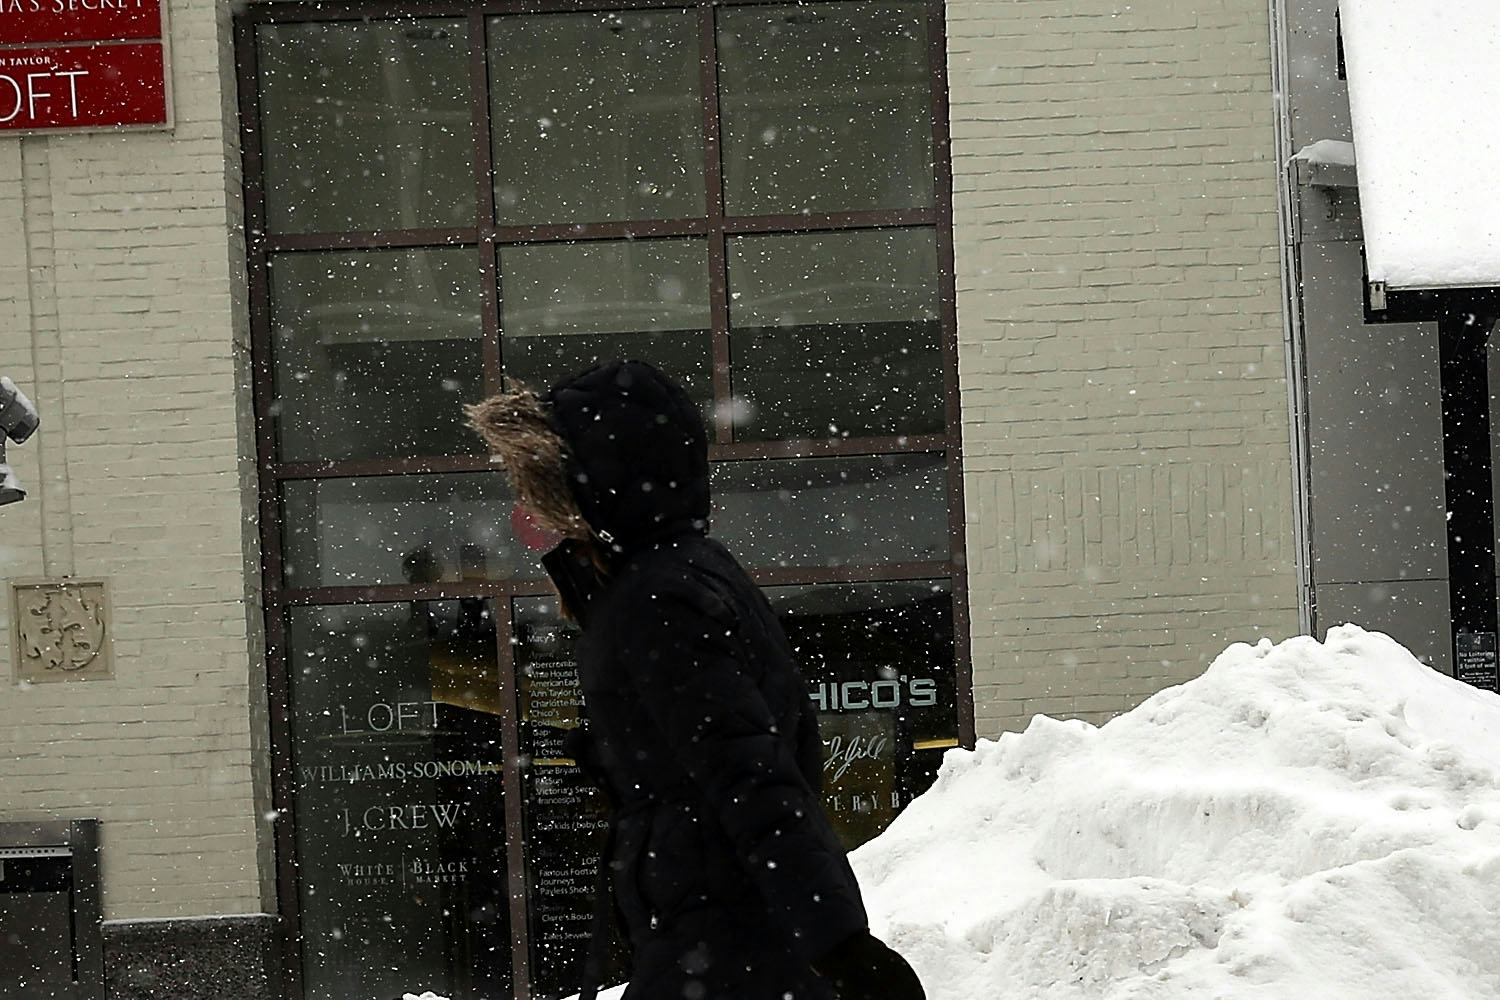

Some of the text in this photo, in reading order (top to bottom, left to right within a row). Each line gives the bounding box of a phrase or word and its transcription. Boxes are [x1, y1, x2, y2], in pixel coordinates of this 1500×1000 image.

[10, 56, 51, 66] TAYLOR
[531, 699, 569, 709] Charlotte
[340, 701, 446, 735] LOFT
[301, 760, 499, 783] WILLIAMS-SONOMA
[340, 860, 469, 876] WHITE BLACK
